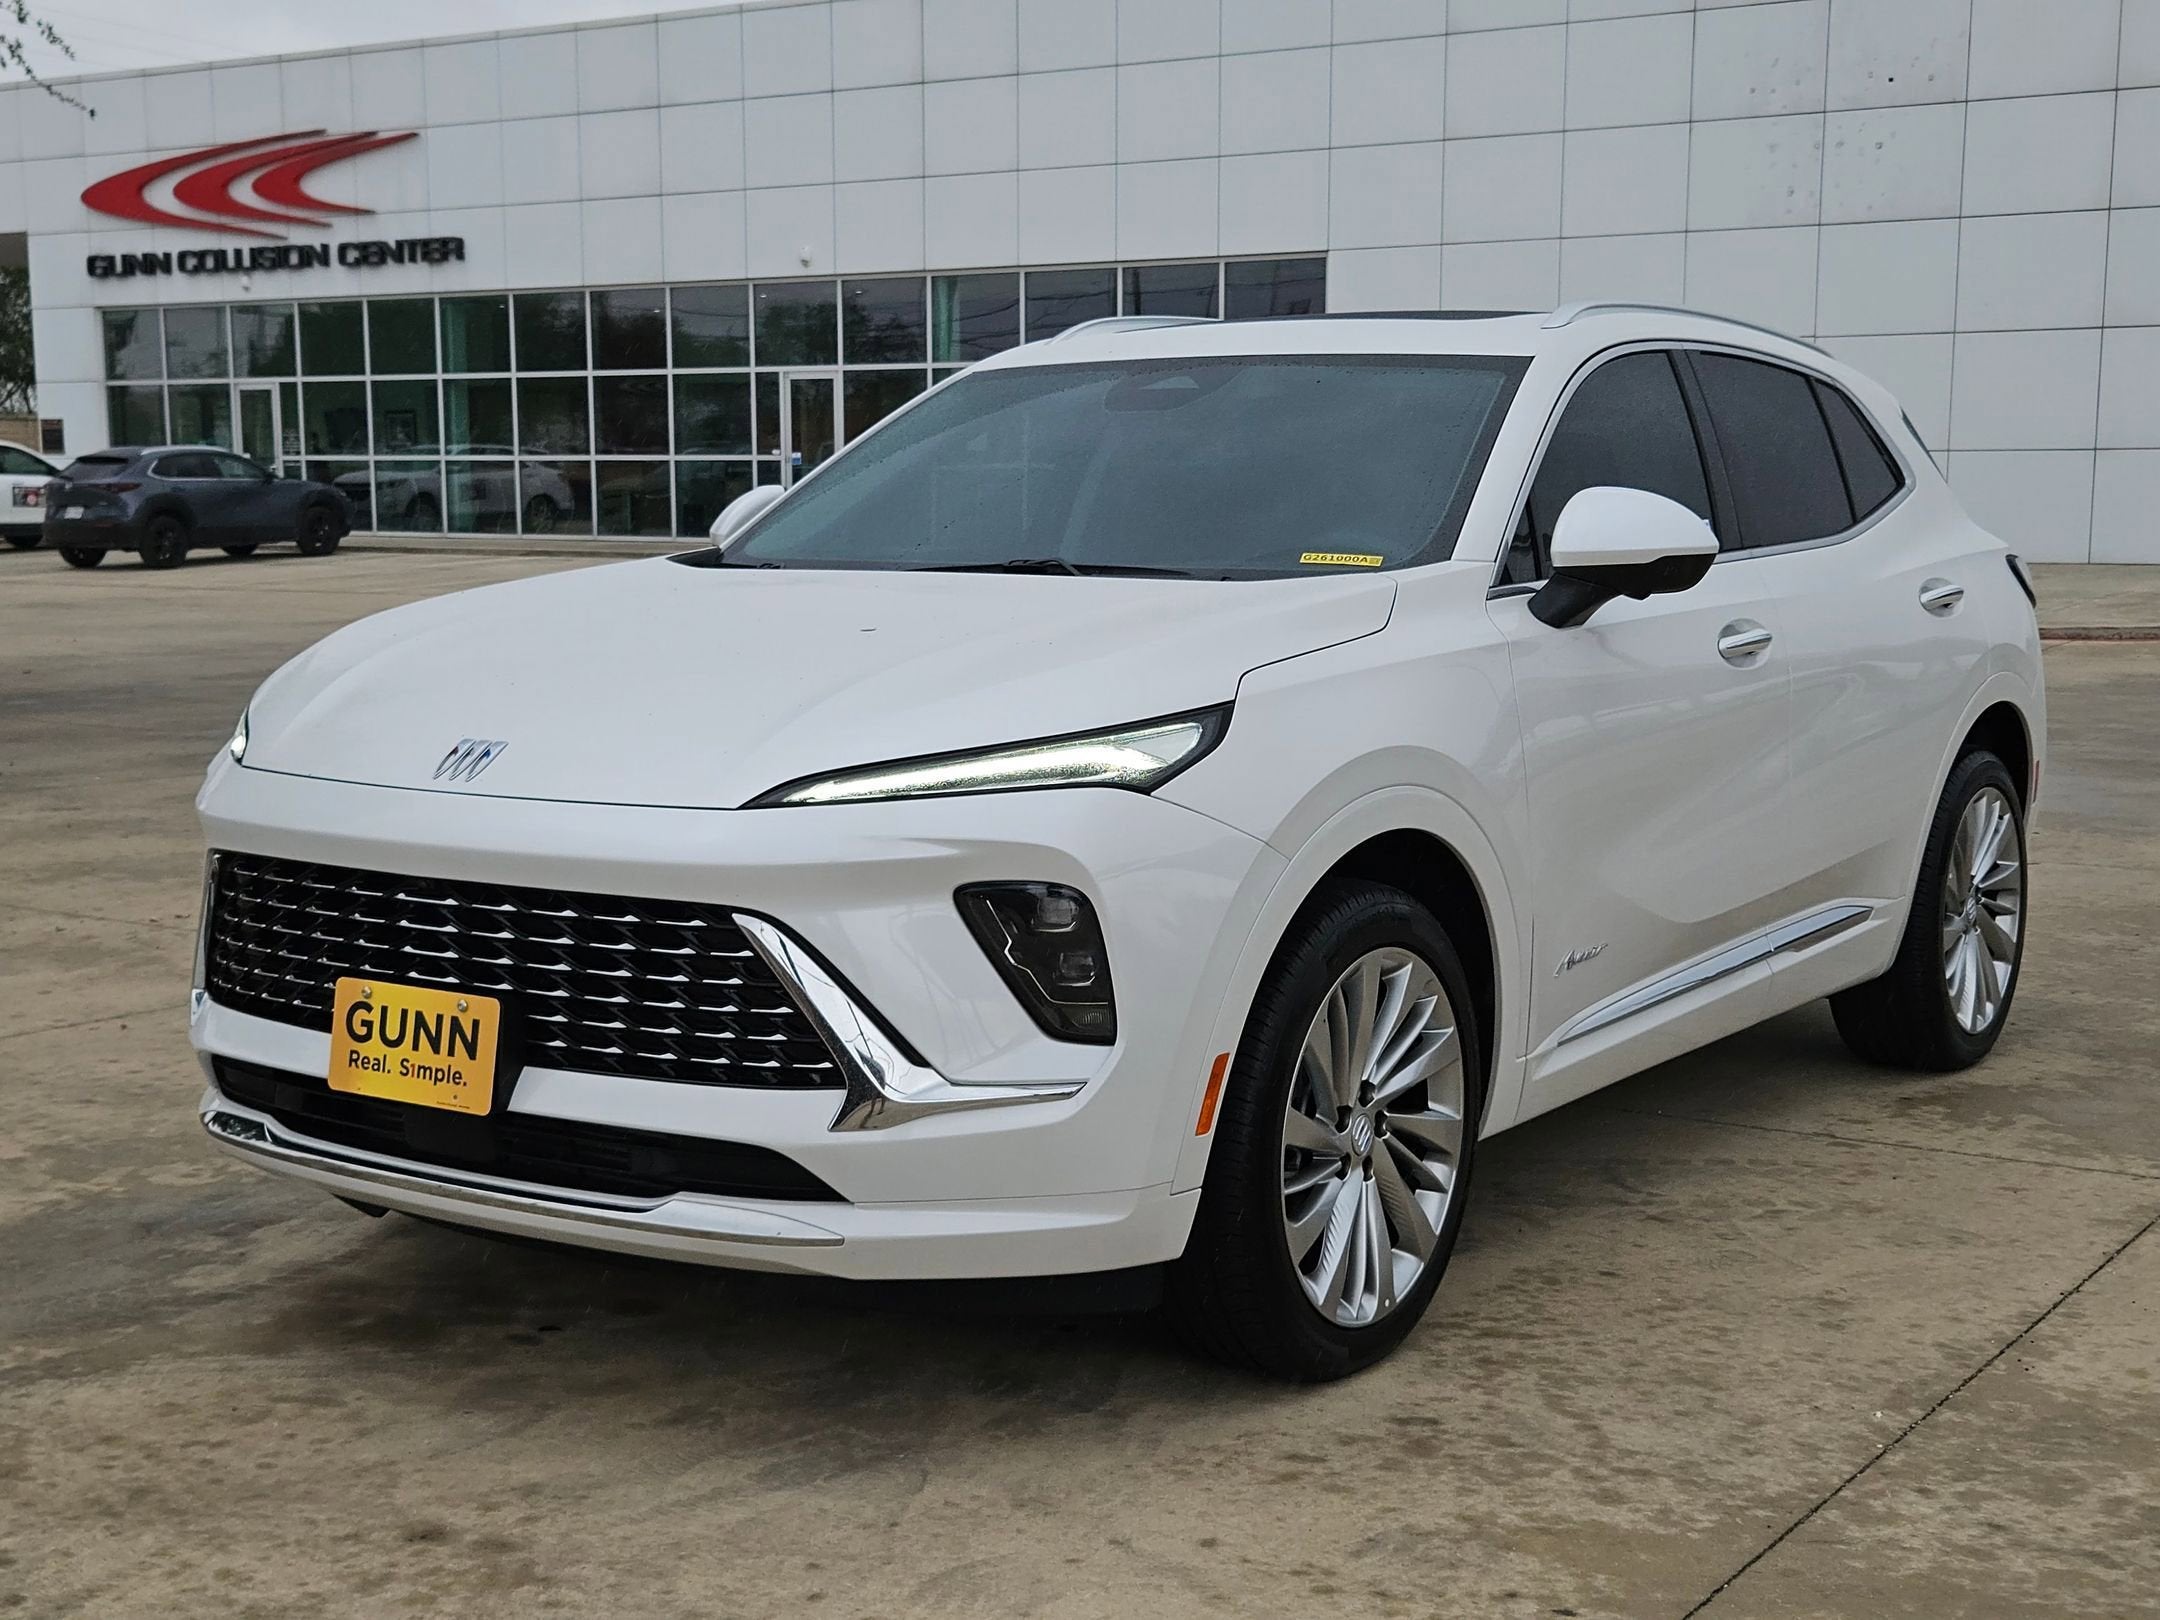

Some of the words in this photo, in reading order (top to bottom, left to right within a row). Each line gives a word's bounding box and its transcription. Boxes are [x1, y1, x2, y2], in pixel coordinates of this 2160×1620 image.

[87, 252, 172, 278] GUNN
[178, 244, 330, 275] COLLISION
[338, 237, 465, 268] CENTER
[346, 1001, 480, 1060] GUNN
[348, 1050, 391, 1073] Real.
